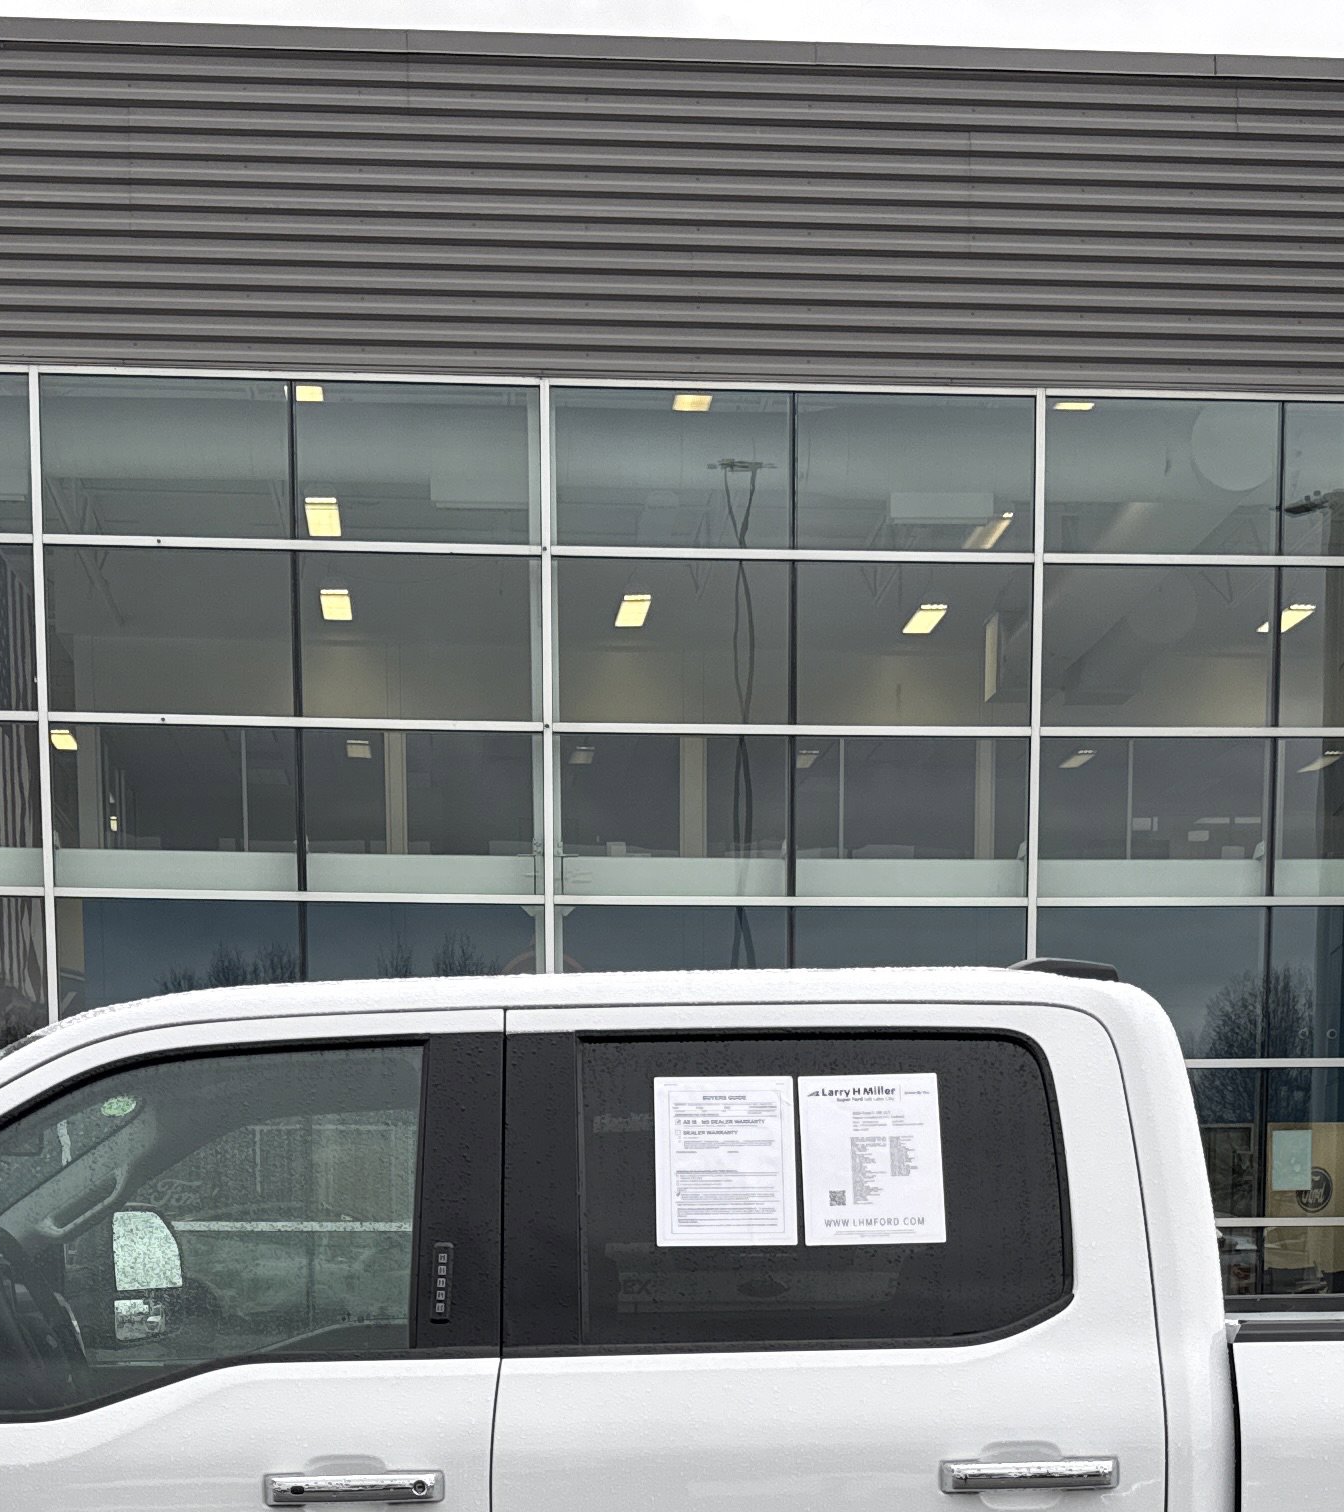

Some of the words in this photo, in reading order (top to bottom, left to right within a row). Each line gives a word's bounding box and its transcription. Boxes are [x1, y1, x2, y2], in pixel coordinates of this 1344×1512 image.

[821, 1087, 851, 1098] Larry
[852, 1087, 861, 1096] H
[862, 1085, 896, 1096] Miller
